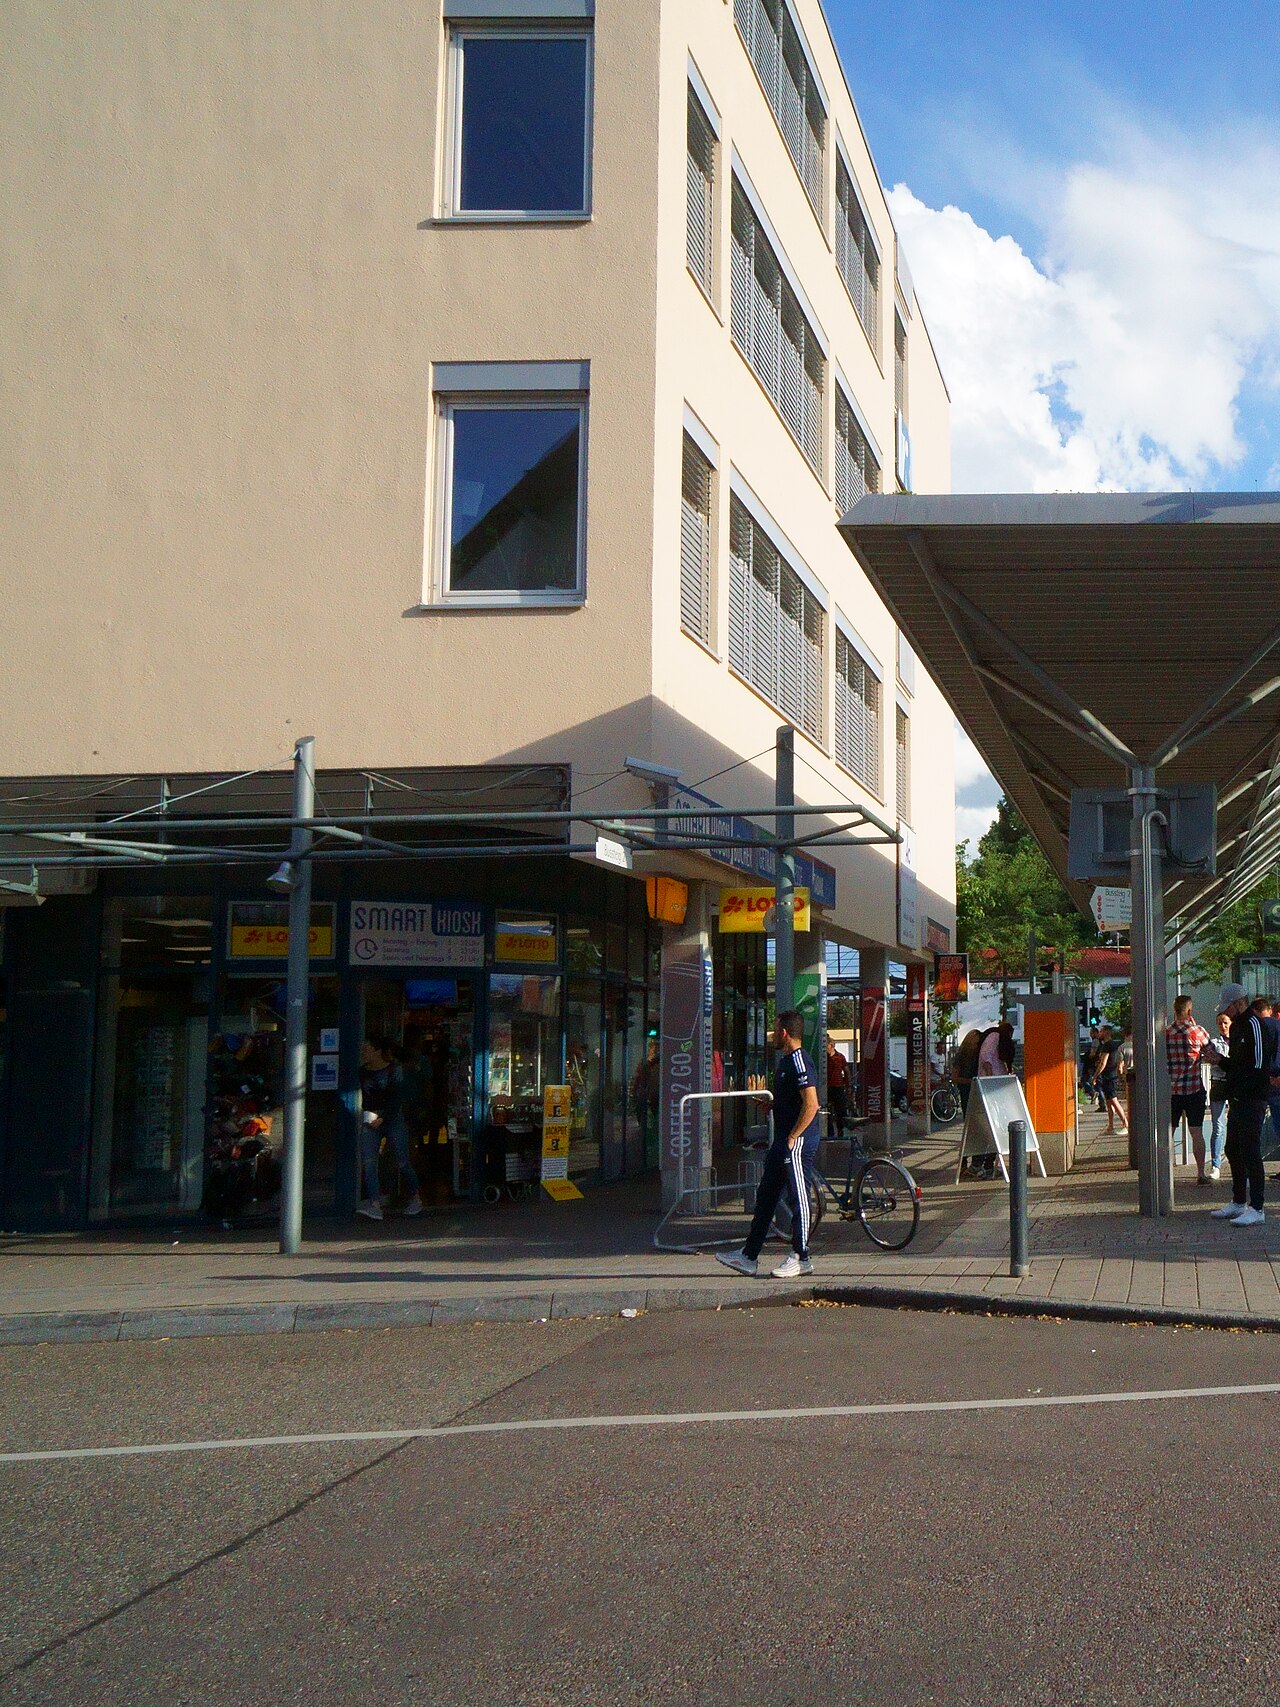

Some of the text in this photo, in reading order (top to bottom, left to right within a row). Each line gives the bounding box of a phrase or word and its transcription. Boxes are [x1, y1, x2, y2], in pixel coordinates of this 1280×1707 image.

[354, 906, 481, 935] SMART KIOSK
[703, 961, 712, 1012] KIOSK
[912, 1016, 924, 1056] KEBAP
[670, 1052, 692, 1077] GO
[866, 1085, 881, 1117] TABAK
[669, 1099, 692, 1158] COFFEE
